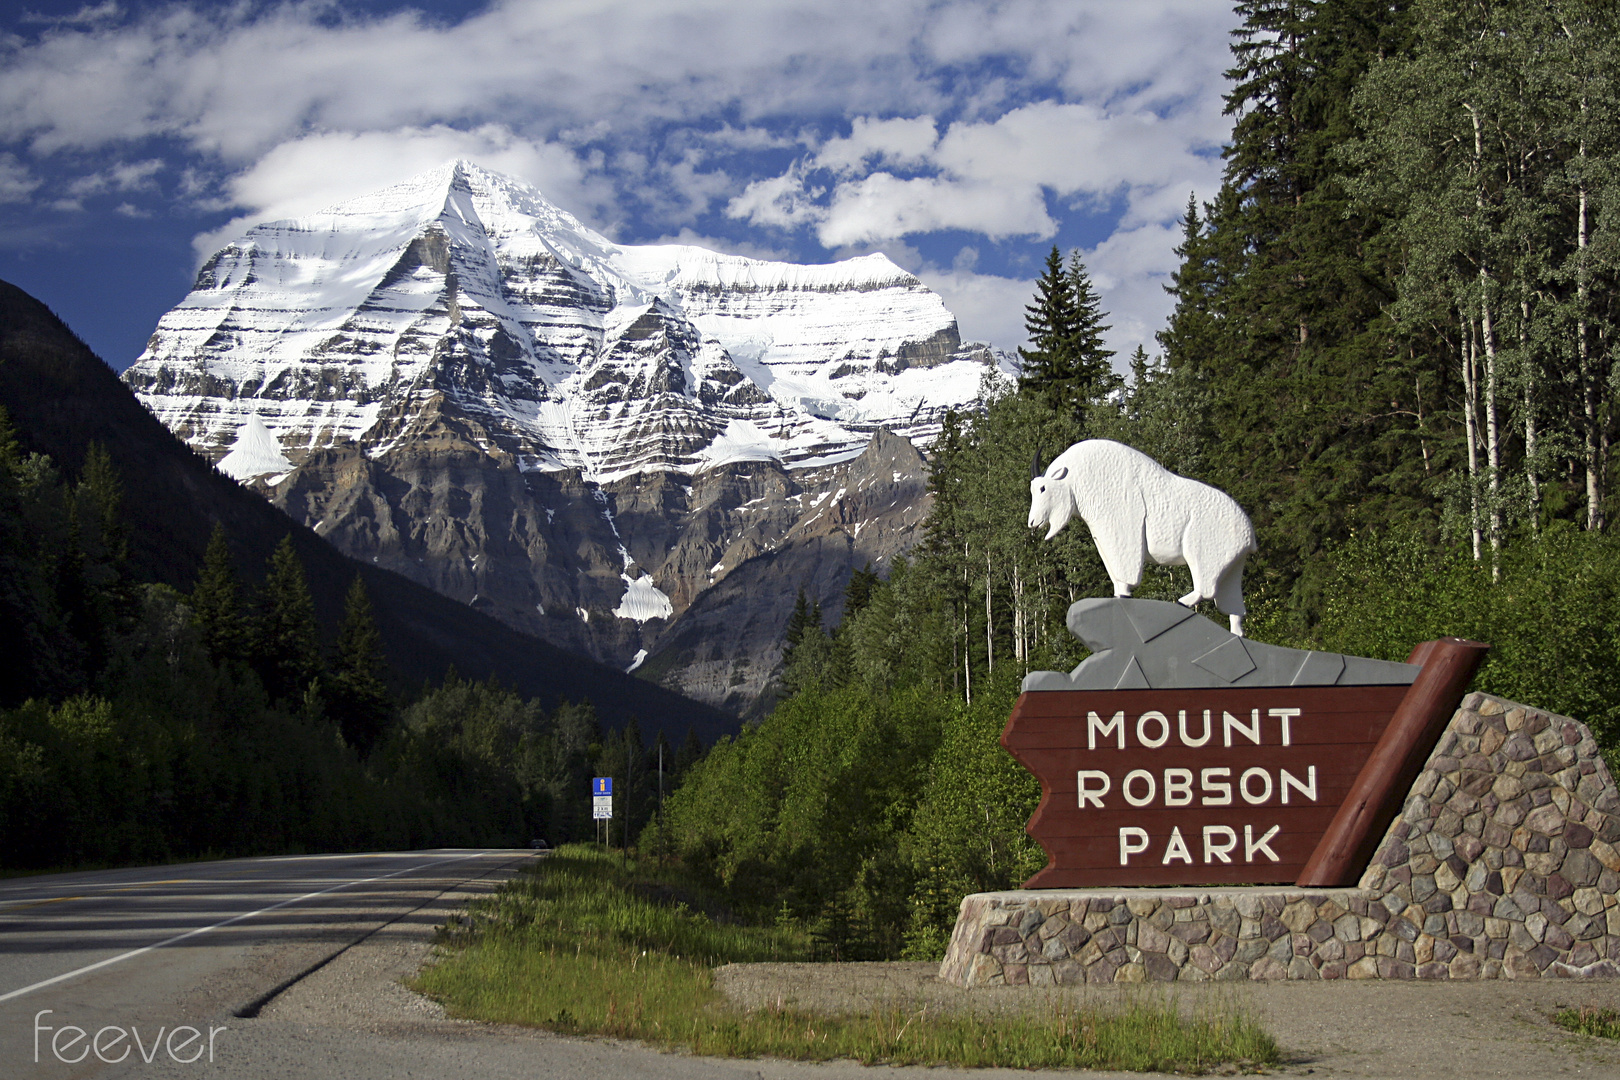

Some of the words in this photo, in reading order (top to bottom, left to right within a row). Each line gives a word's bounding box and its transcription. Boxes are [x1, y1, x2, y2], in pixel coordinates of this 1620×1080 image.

[1087, 708, 1301, 750] MOUNT
[1077, 765, 1317, 808] ROBSON
[1119, 824, 1281, 866] PARK
